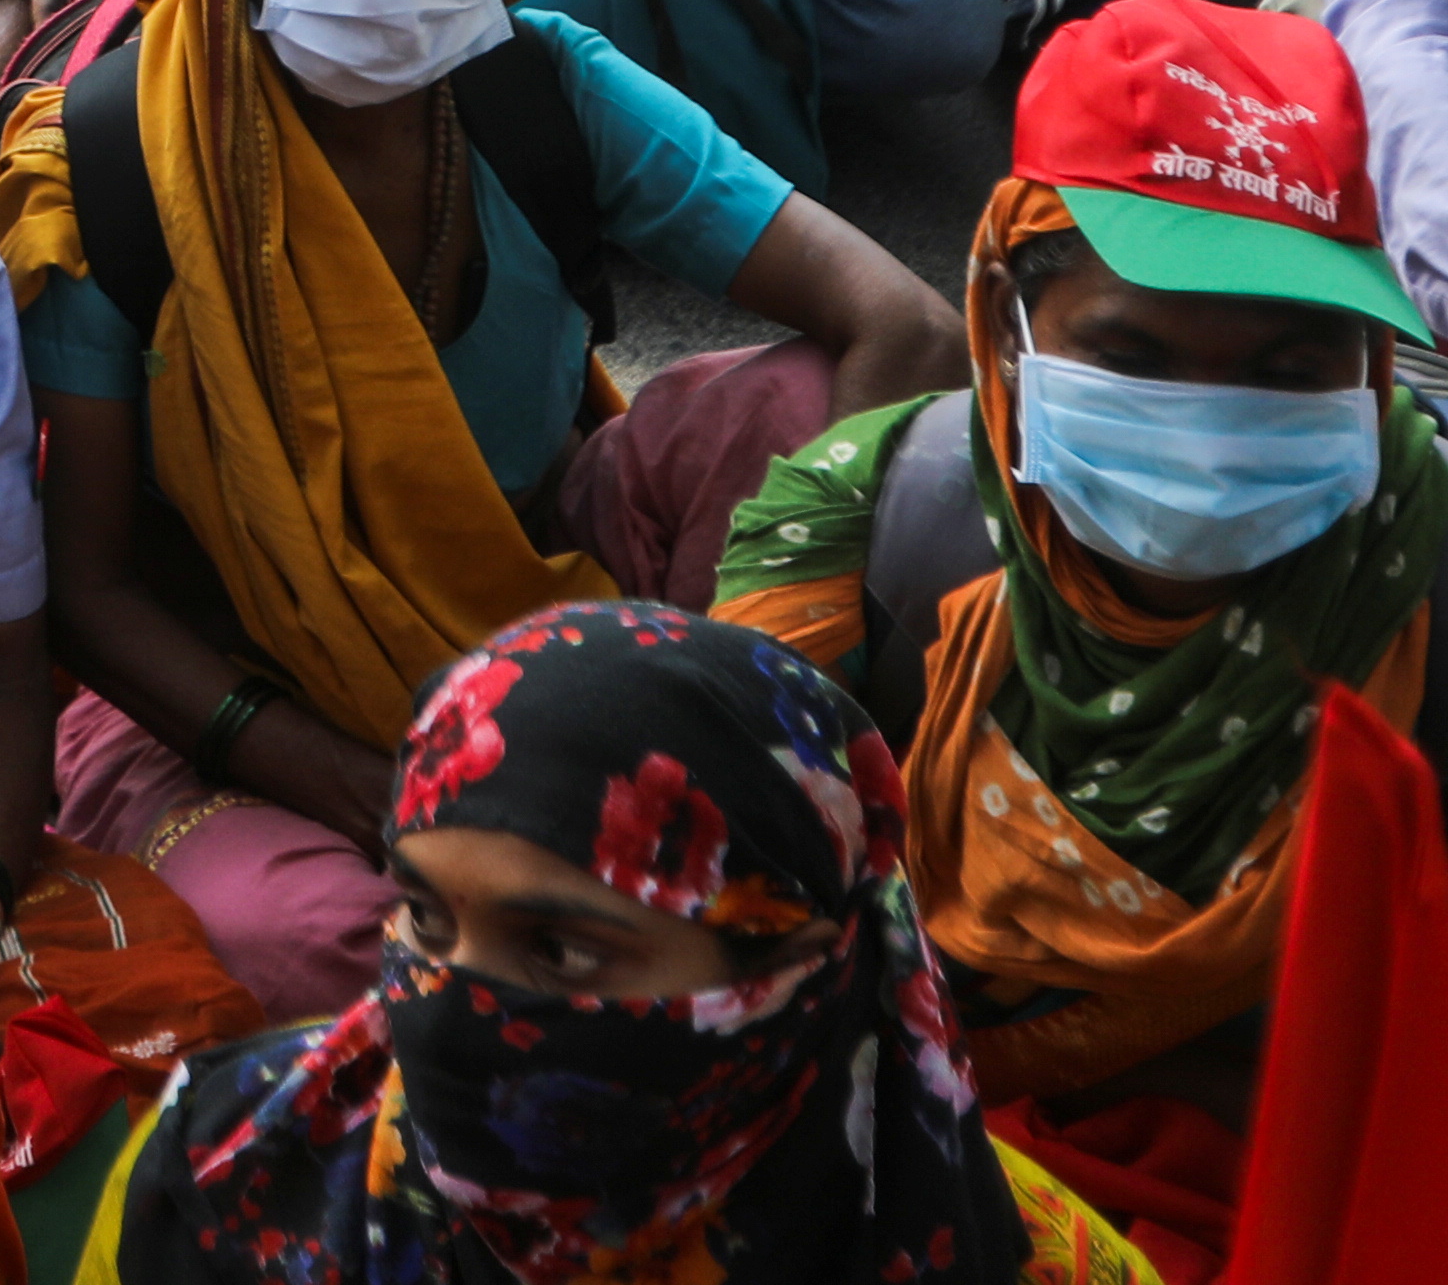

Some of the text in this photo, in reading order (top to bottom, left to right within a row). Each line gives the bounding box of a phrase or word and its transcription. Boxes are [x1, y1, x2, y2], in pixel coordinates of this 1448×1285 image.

[1152, 142, 1341, 223] लोक संघर्ष मोर्चा
